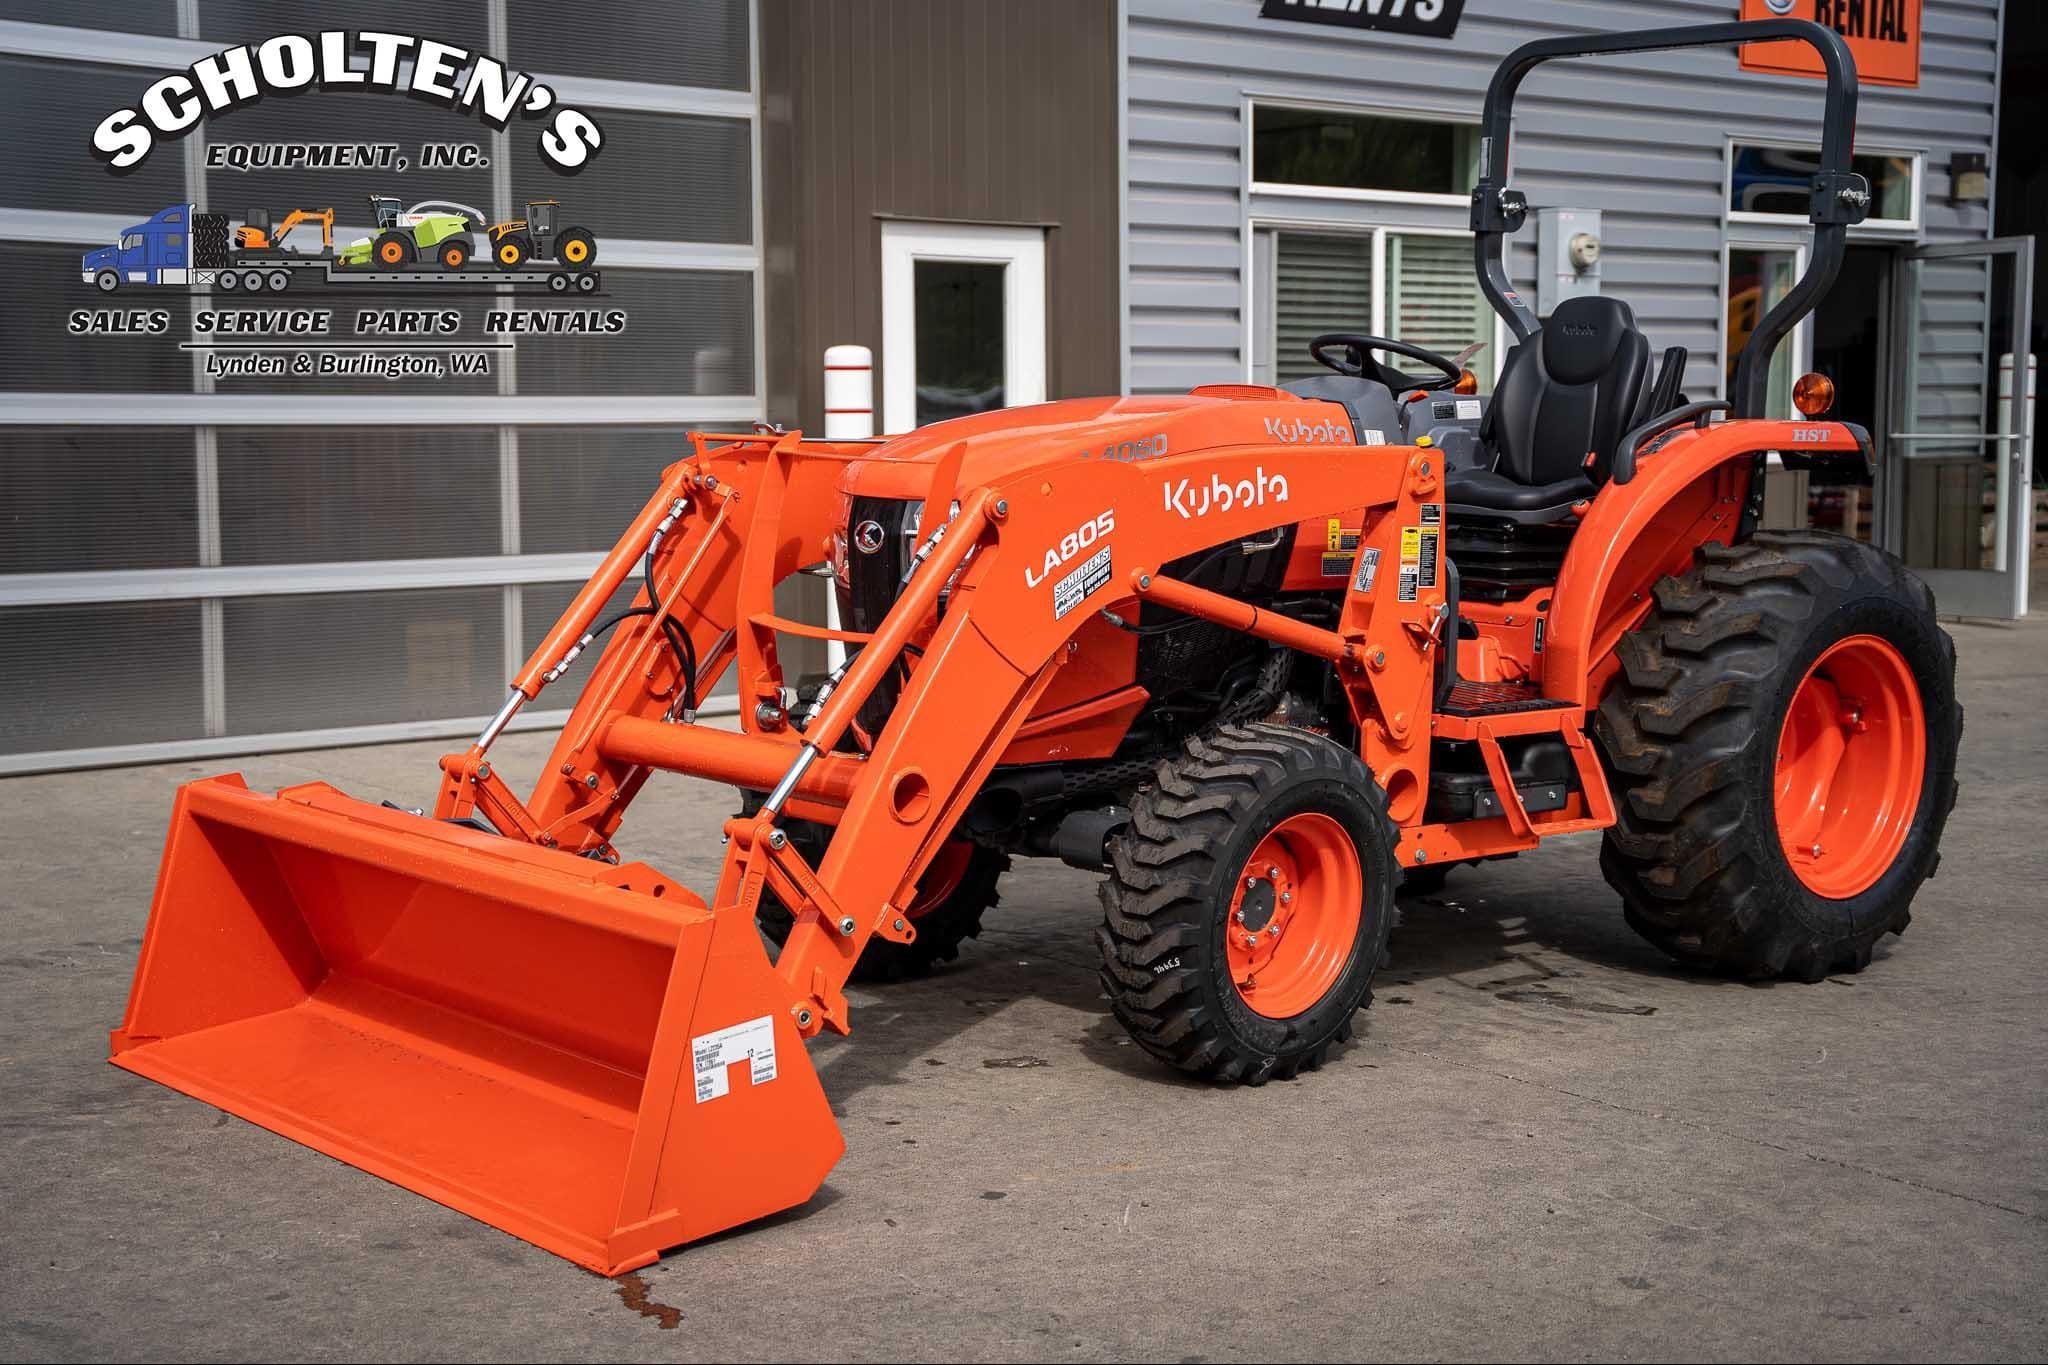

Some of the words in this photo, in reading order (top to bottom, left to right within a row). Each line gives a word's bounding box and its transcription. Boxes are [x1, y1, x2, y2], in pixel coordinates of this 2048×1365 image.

[1263, 416, 1352, 443] Kubota
[1792, 428, 1832, 442] HST
[1164, 466, 1290, 519] Kubota
[1024, 507, 1115, 589] LA805
[746, 1048, 755, 1059] 12
